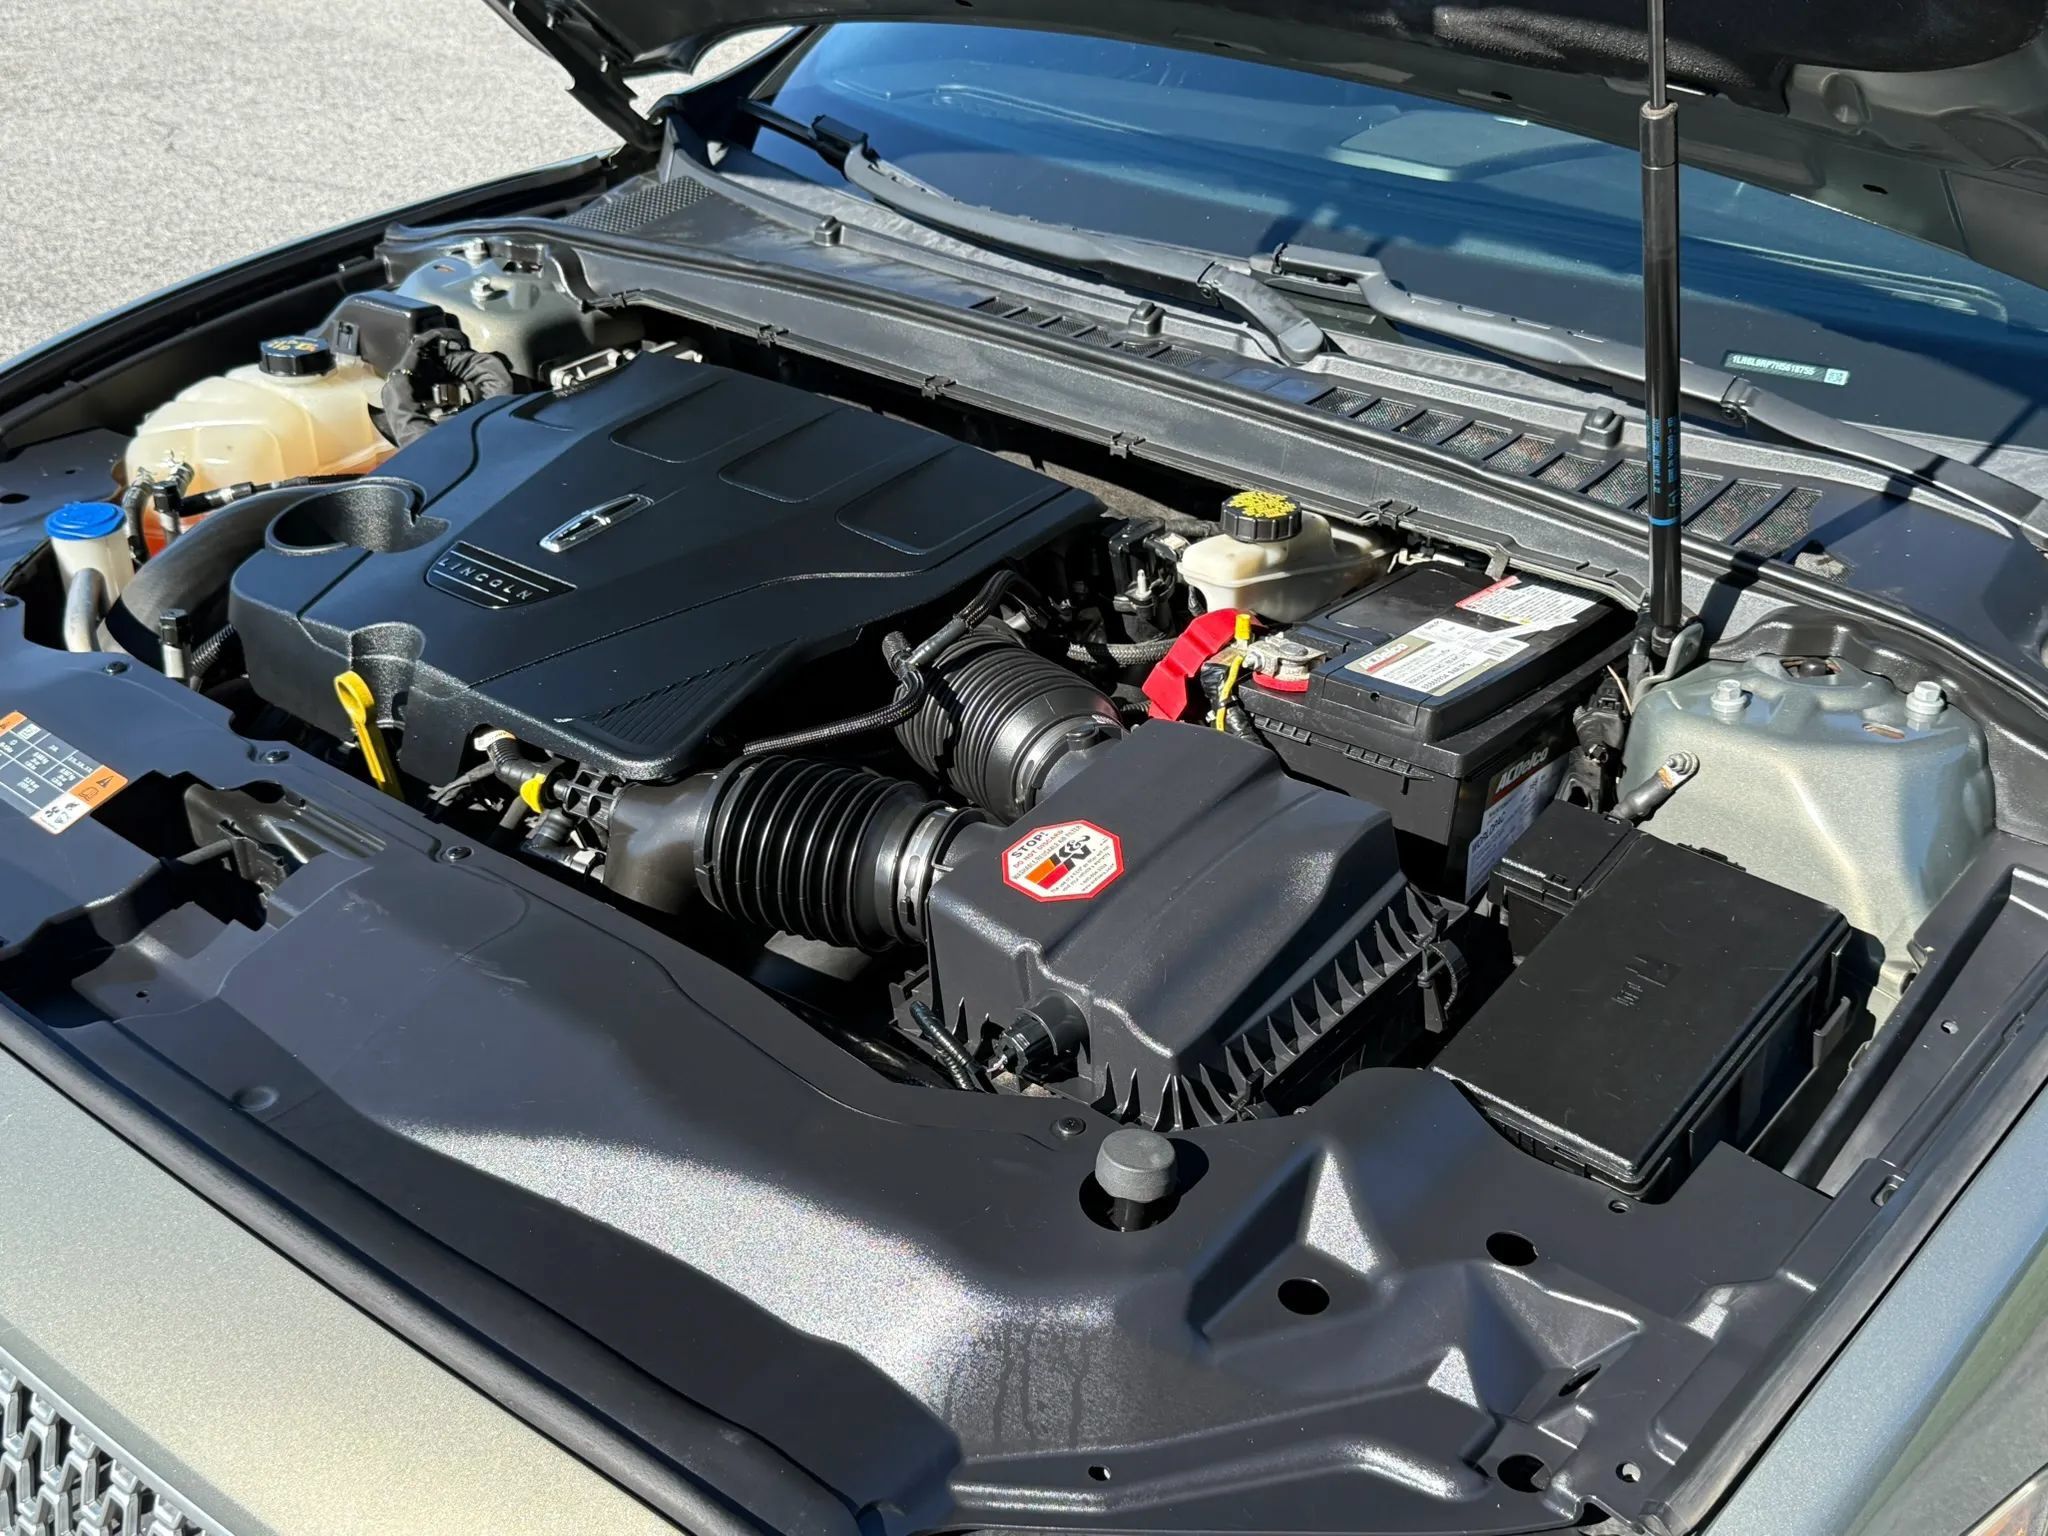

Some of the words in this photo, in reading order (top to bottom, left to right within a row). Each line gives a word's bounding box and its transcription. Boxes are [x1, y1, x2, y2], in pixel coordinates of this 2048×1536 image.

[438, 558, 533, 600] LINCOLN
[1359, 643, 1409, 669] ACDelco
[1495, 747, 1549, 793] ACDelco
[1011, 831, 1049, 859] STOP!
[1013, 859, 1023, 868] DO
[1023, 848, 1037, 860] NOT
[1037, 829, 1064, 850] DISCARD
[1049, 835, 1091, 871] K&N
